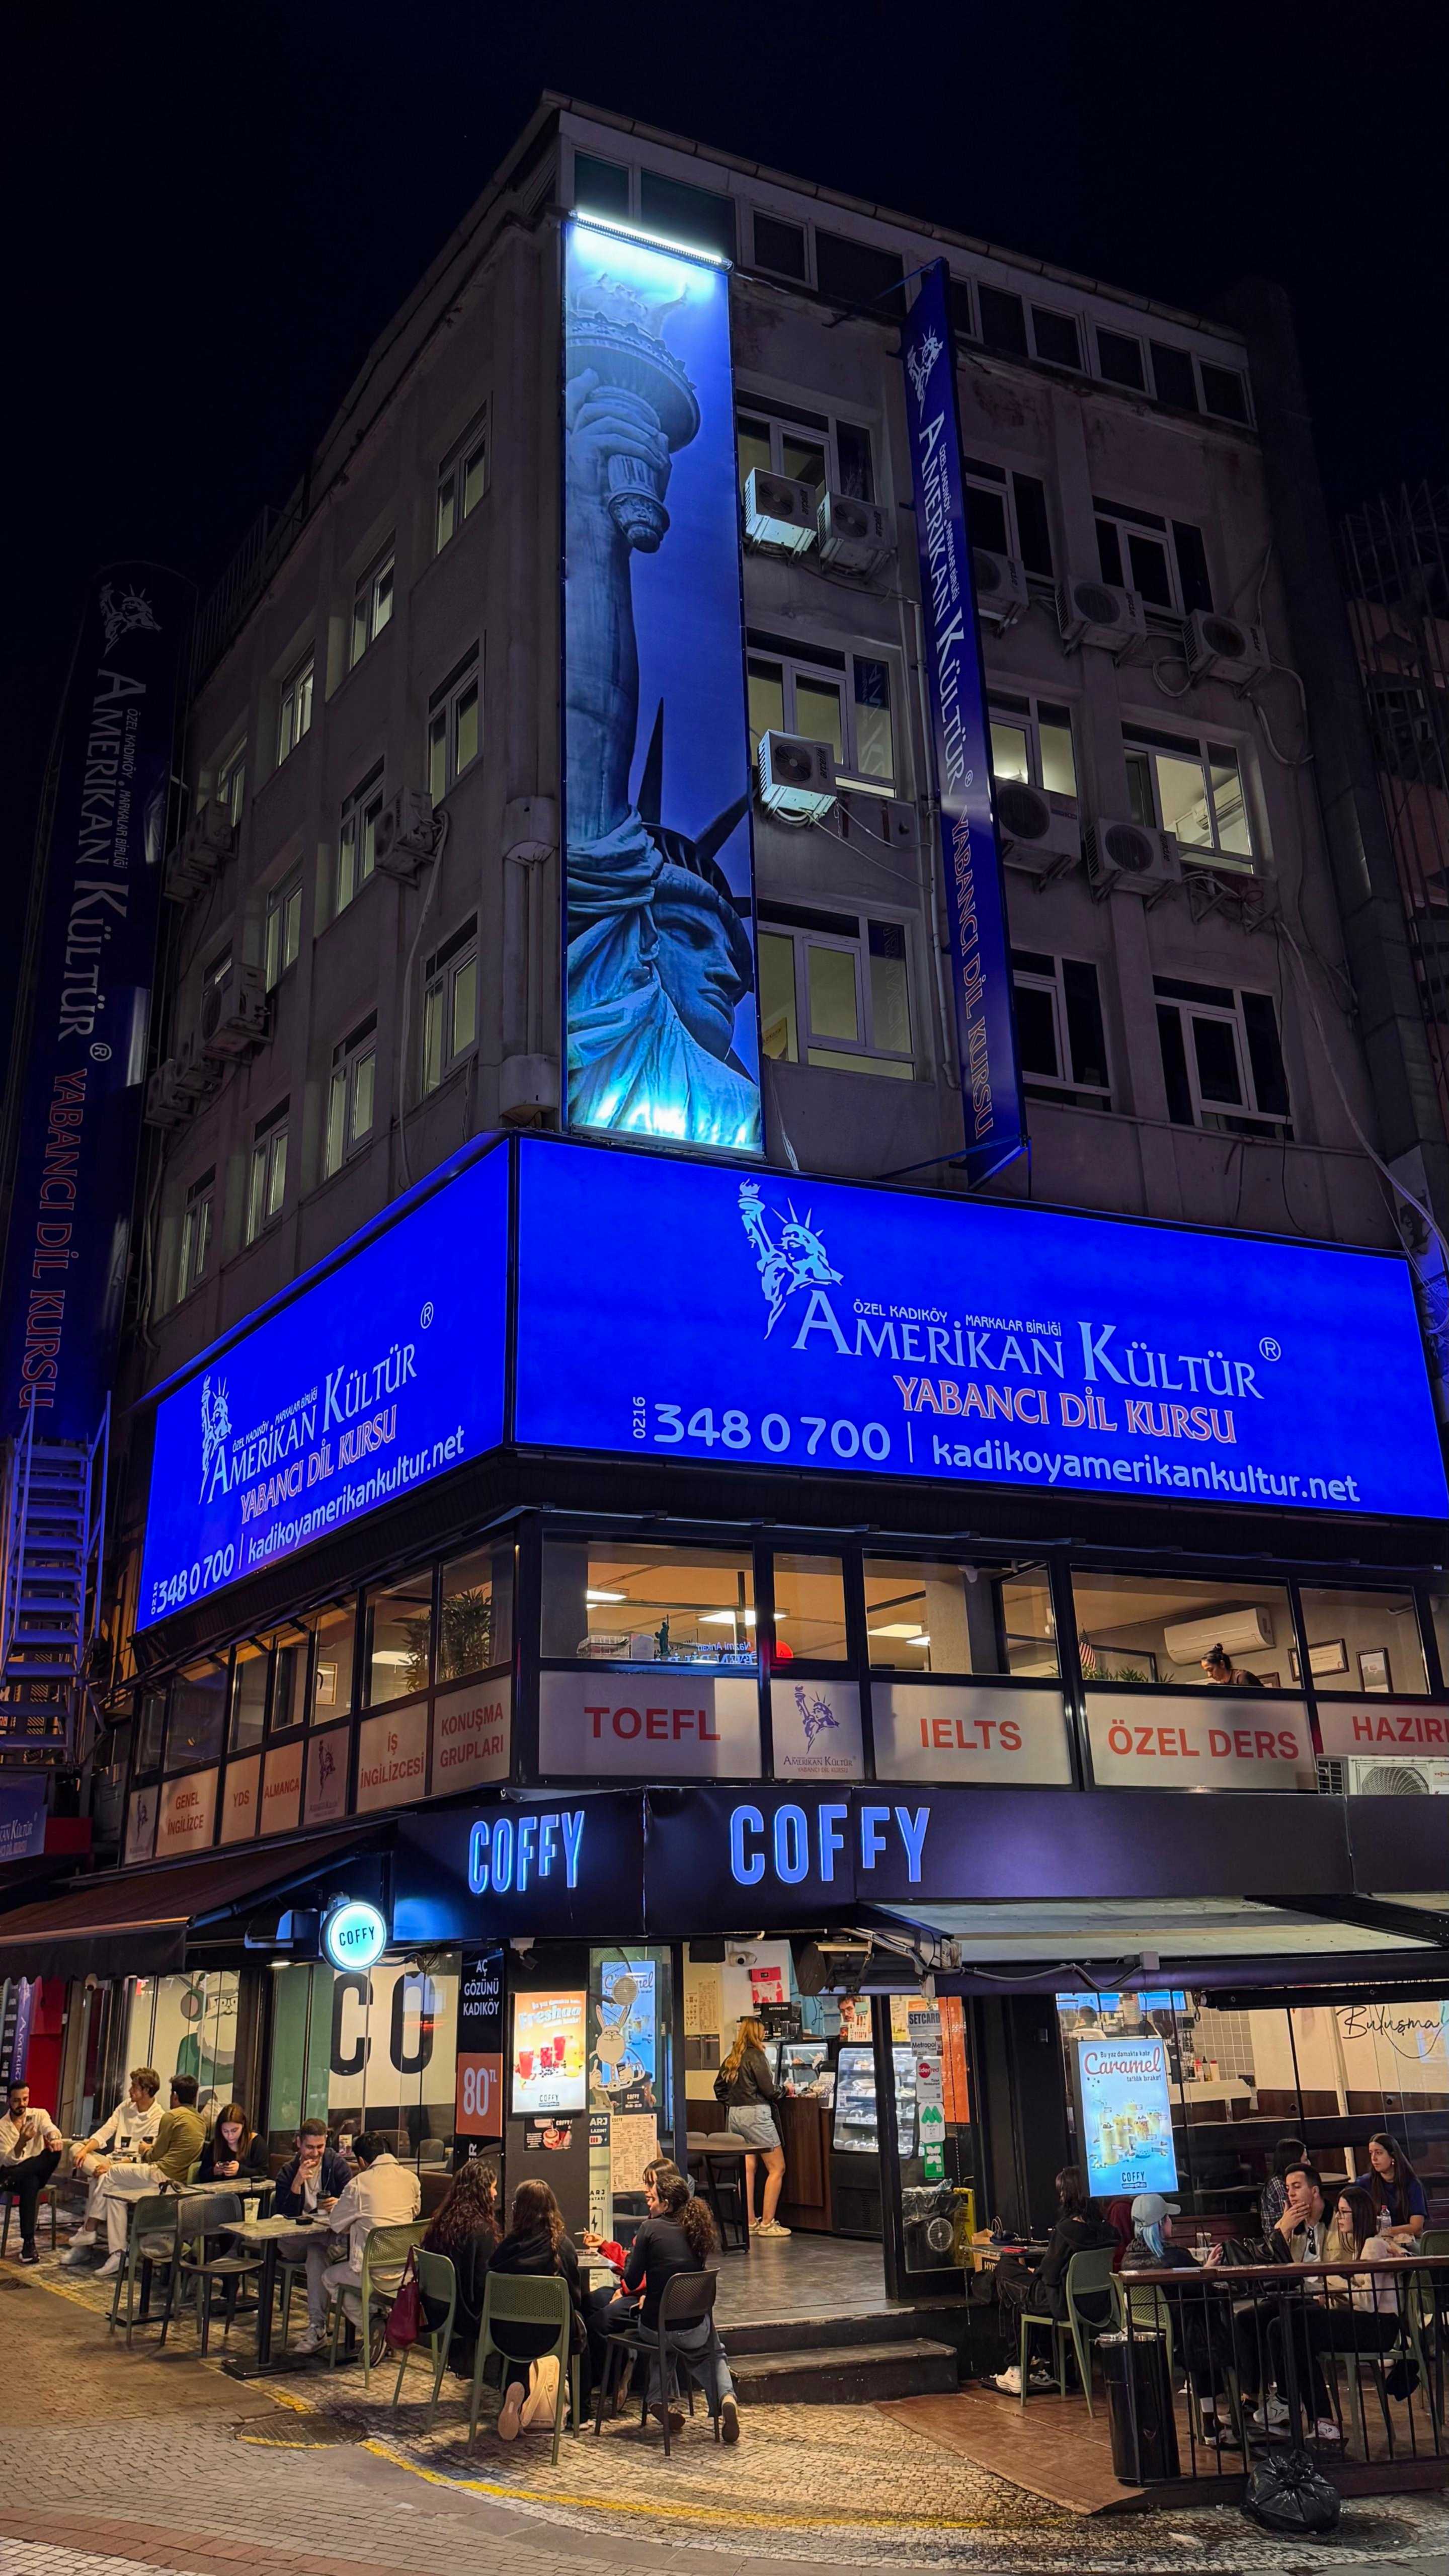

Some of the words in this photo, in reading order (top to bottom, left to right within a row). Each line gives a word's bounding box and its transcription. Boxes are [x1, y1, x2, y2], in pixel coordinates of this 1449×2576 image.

[919, 410, 951, 627] AMERİKAN
[936, 607, 966, 796] KÜLTÜR
[126, 708, 138, 731] ÖZEL
[75, 668, 146, 866] AMERİKAN
[122, 735, 135, 779] KADIKÖY
[116, 790, 131, 843] MARKALAR
[113, 844, 127, 869] BİRLİĞİ
[951, 804, 979, 957] YABANCI
[58, 880, 129, 1041] KÜLTÜR
[962, 953, 985, 1019] DİL
[968, 1016, 994, 1140] KURSU
[39, 1068, 88, 1211] YABANCI
[33, 1223, 79, 1279] DİL
[853, 1299, 886, 1316] ÖZEL
[890, 1305, 948, 1323] KADIKÖY
[965, 1314, 1023, 1332] MARKALAR
[1026, 1319, 1062, 1337] BİRLİĞİ
[19, 1289, 66, 1409] KURSU
[791, 1290, 1065, 1379] AMERİKAN
[1077, 1321, 1265, 1400] KÜLTÜR
[208, 1405, 317, 1503] AMERİKAN
[322, 1343, 417, 1433] KÜLTÜR
[632, 1396, 647, 1439] 0216
[893, 1375, 1050, 1424] YABANCI
[1060, 1387, 1118, 1431] DİL
[1124, 1399, 1237, 1444] KURSU
[241, 1460, 303, 1524] YABANCI
[307, 1439, 334, 1487] DİL
[339, 1404, 397, 1469] KURSU
[933, 1434, 1360, 1502] kadikoyamerikankultur.net
[248, 1425, 465, 1563] kadikoyamerikankultur.net
[441, 1702, 504, 1737] KONUŞMA
[584, 1707, 721, 1741] TOEFL
[920, 1718, 1022, 1751] IELTS
[388, 1731, 398, 1755] İŞ
[440, 1735, 504, 1768] GRUPLARI
[1108, 1719, 1200, 1757] ÖZEL
[1209, 1729, 1300, 1759] DERS
[264, 1778, 300, 1799] ALMANCA
[360, 1751, 424, 1789] İNGİLİZCESİ
[176, 1792, 199, 1810] GENEL
[233, 1790, 250, 1808] YDS
[167, 1814, 204, 1836] İNGİLİZCE
[468, 1810, 585, 1894] COFFY
[730, 1804, 931, 1886] COFFY
[339, 1925, 375, 1947] COFFY
[476, 1959, 488, 1974] AÇ
[464, 1978, 499, 1996] GÖZÜNÜ
[463, 1999, 499, 2016] KADIKÖY
[909, 2013, 941, 2025] SETCARD
[1336, 2005, 1440, 2039] Buluşma
[1084, 2047, 1161, 2075] Caramel
[463, 2067, 489, 2117] 80
[489, 2068, 497, 2083] TL
[539, 2094, 558, 2102] COFFY
[590, 2117, 608, 2126] ARJ
[1122, 2171, 1145, 2182] COFFY
